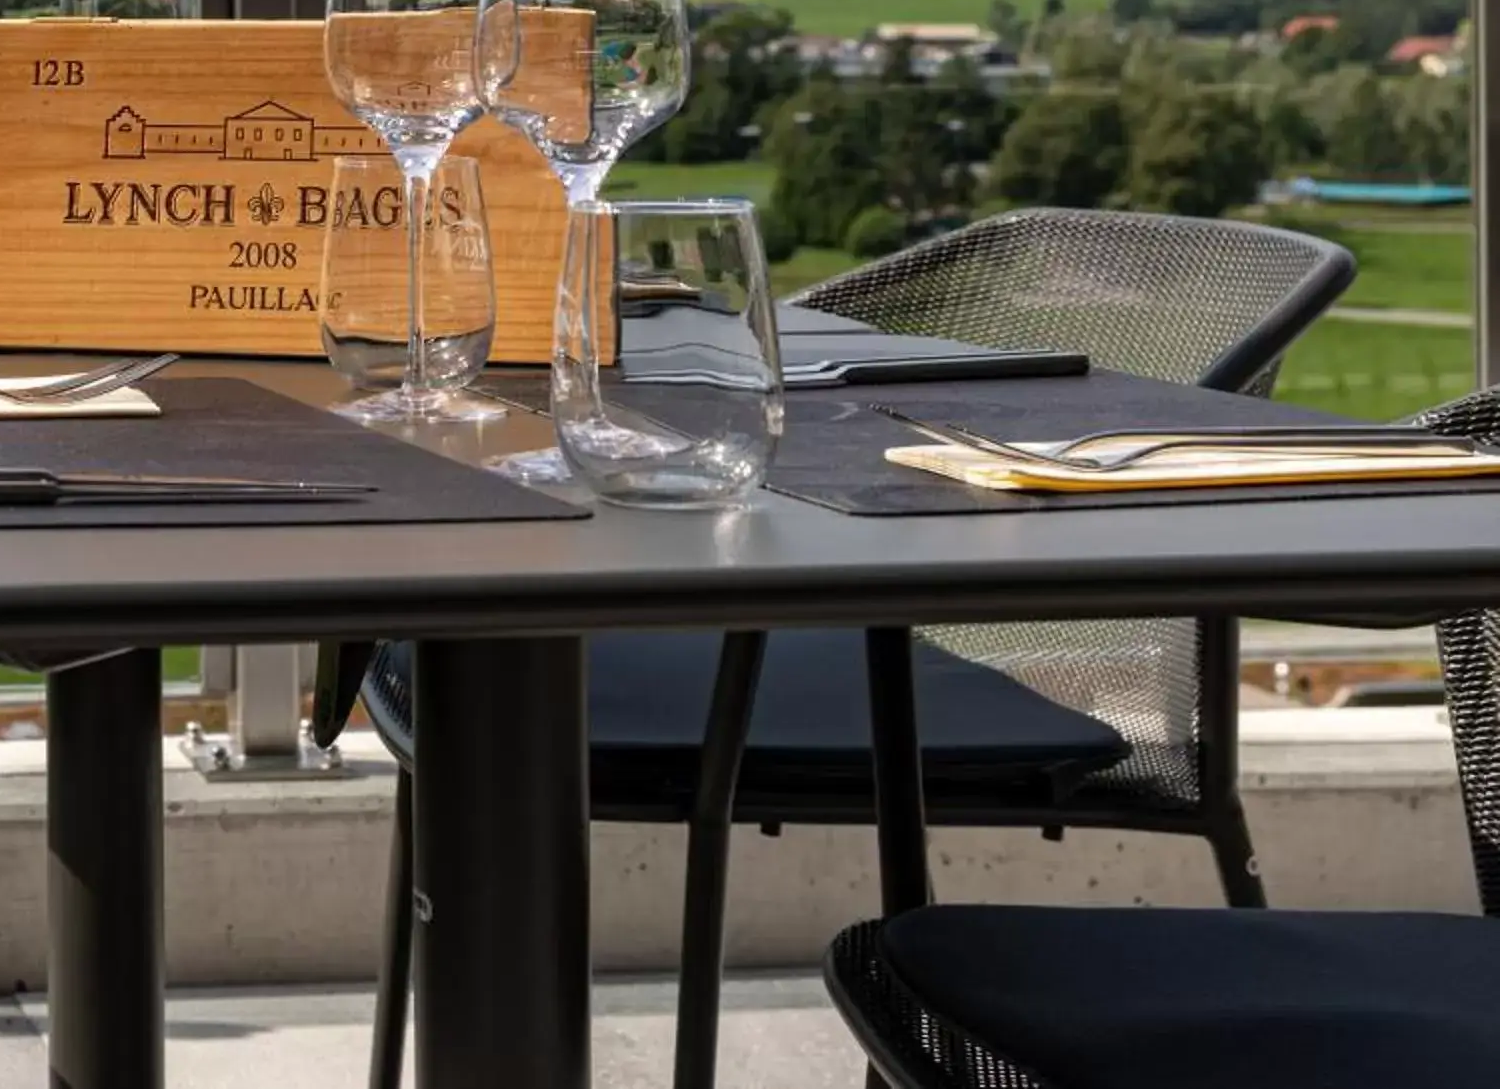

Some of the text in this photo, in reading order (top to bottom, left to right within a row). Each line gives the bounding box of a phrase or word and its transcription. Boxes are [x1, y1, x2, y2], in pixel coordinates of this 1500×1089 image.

[63, 181, 464, 230] LYNCH BAGS
[229, 242, 298, 269] 2008
